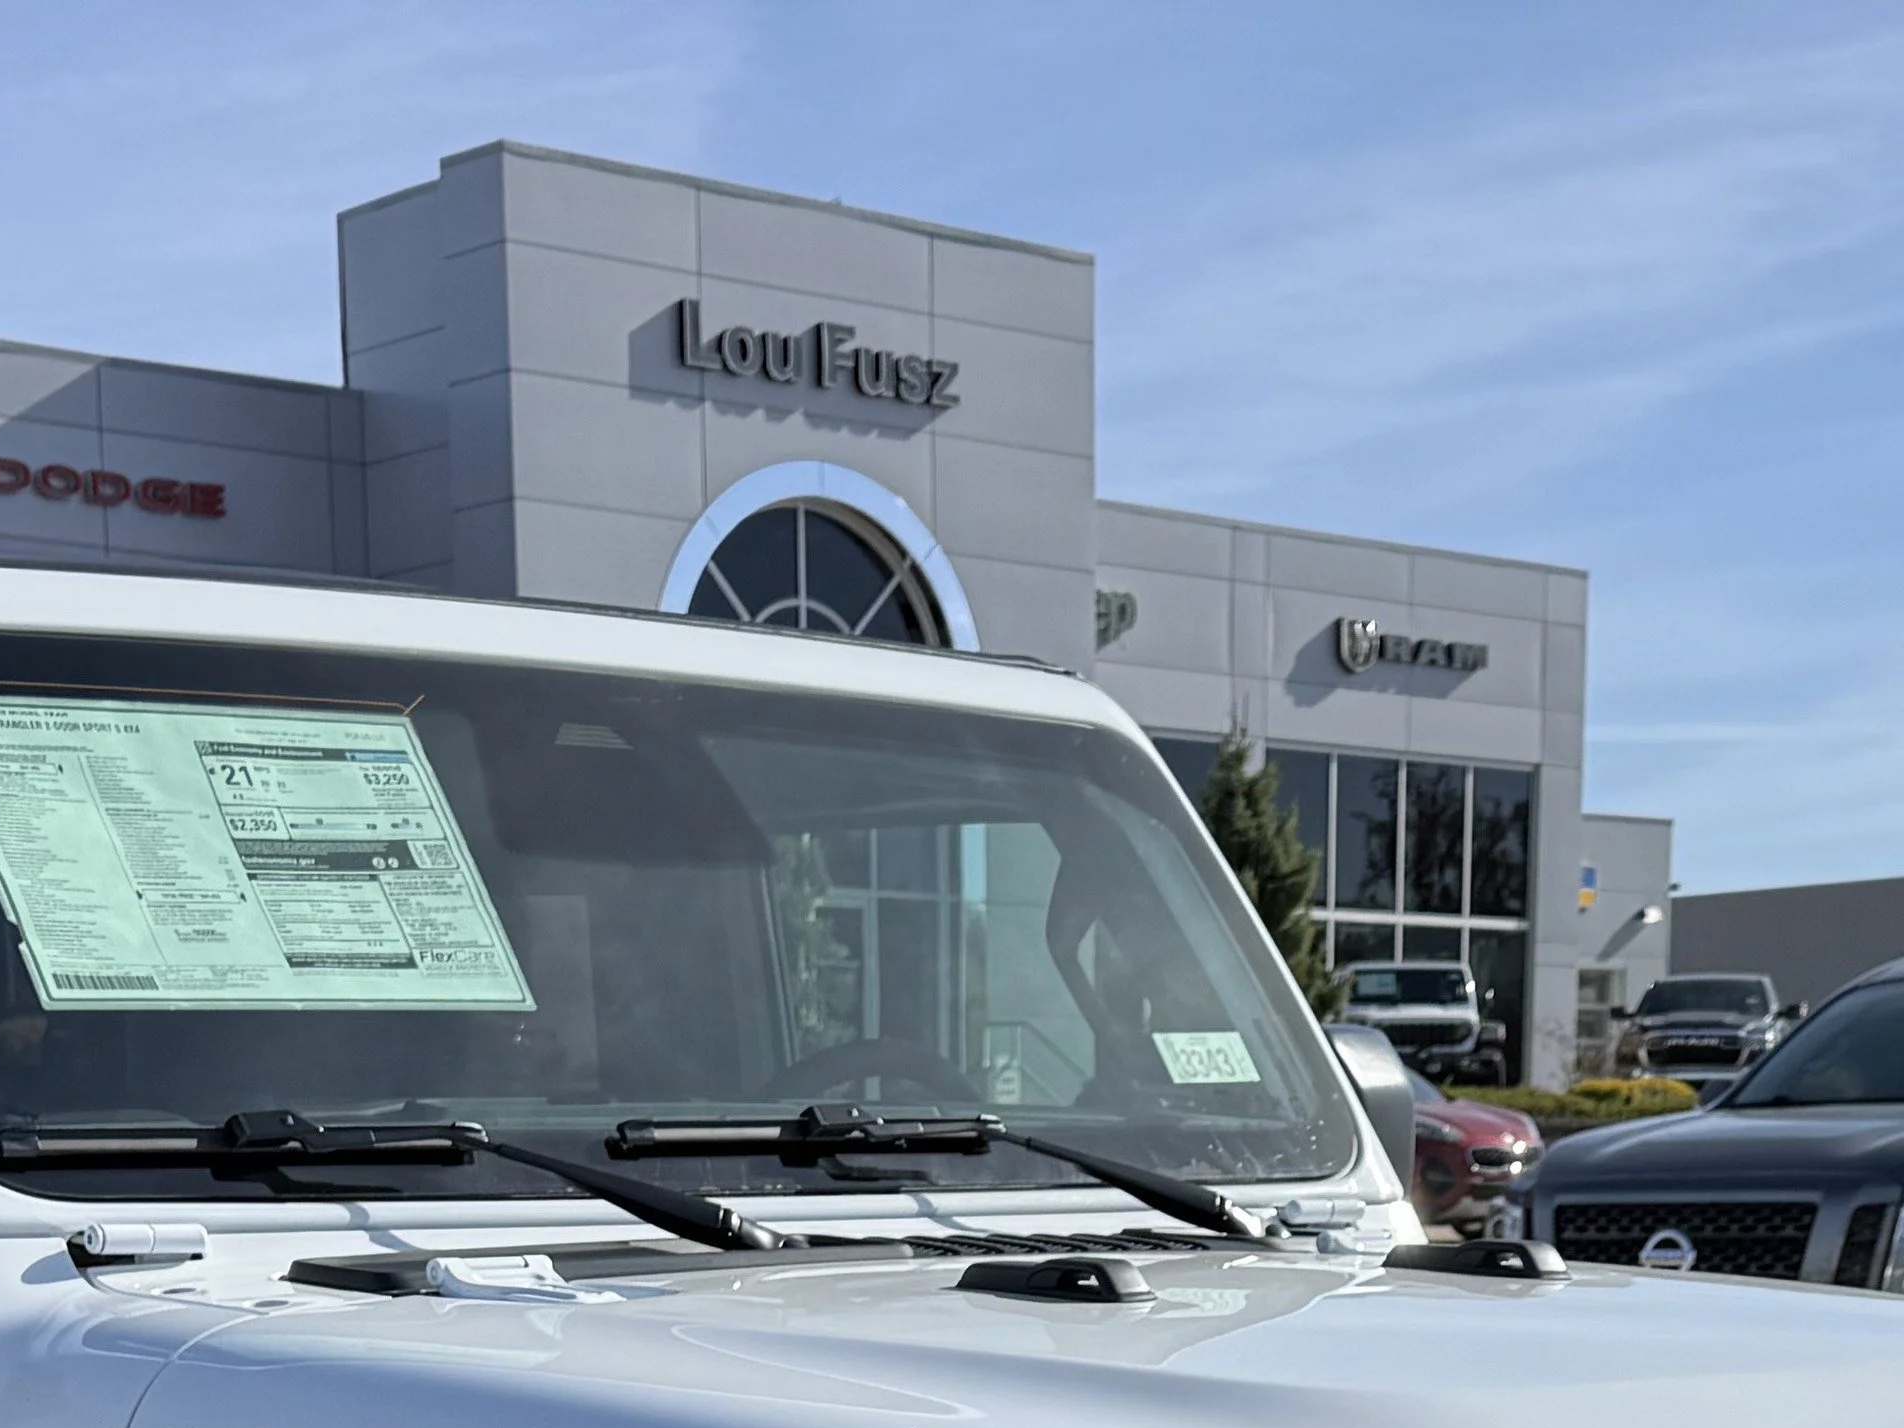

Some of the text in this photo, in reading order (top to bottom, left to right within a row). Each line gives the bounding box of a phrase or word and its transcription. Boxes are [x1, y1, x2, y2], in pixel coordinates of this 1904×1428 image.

[677, 296, 960, 408] Lou Fusz
[1379, 634, 1489, 671] RAM
[82, 722, 112, 733] SPORT
[220, 764, 254, 787] 21
[363, 773, 410, 786] $3,250
[229, 818, 278, 832] $2,350
[419, 949, 496, 964] FlexCare
